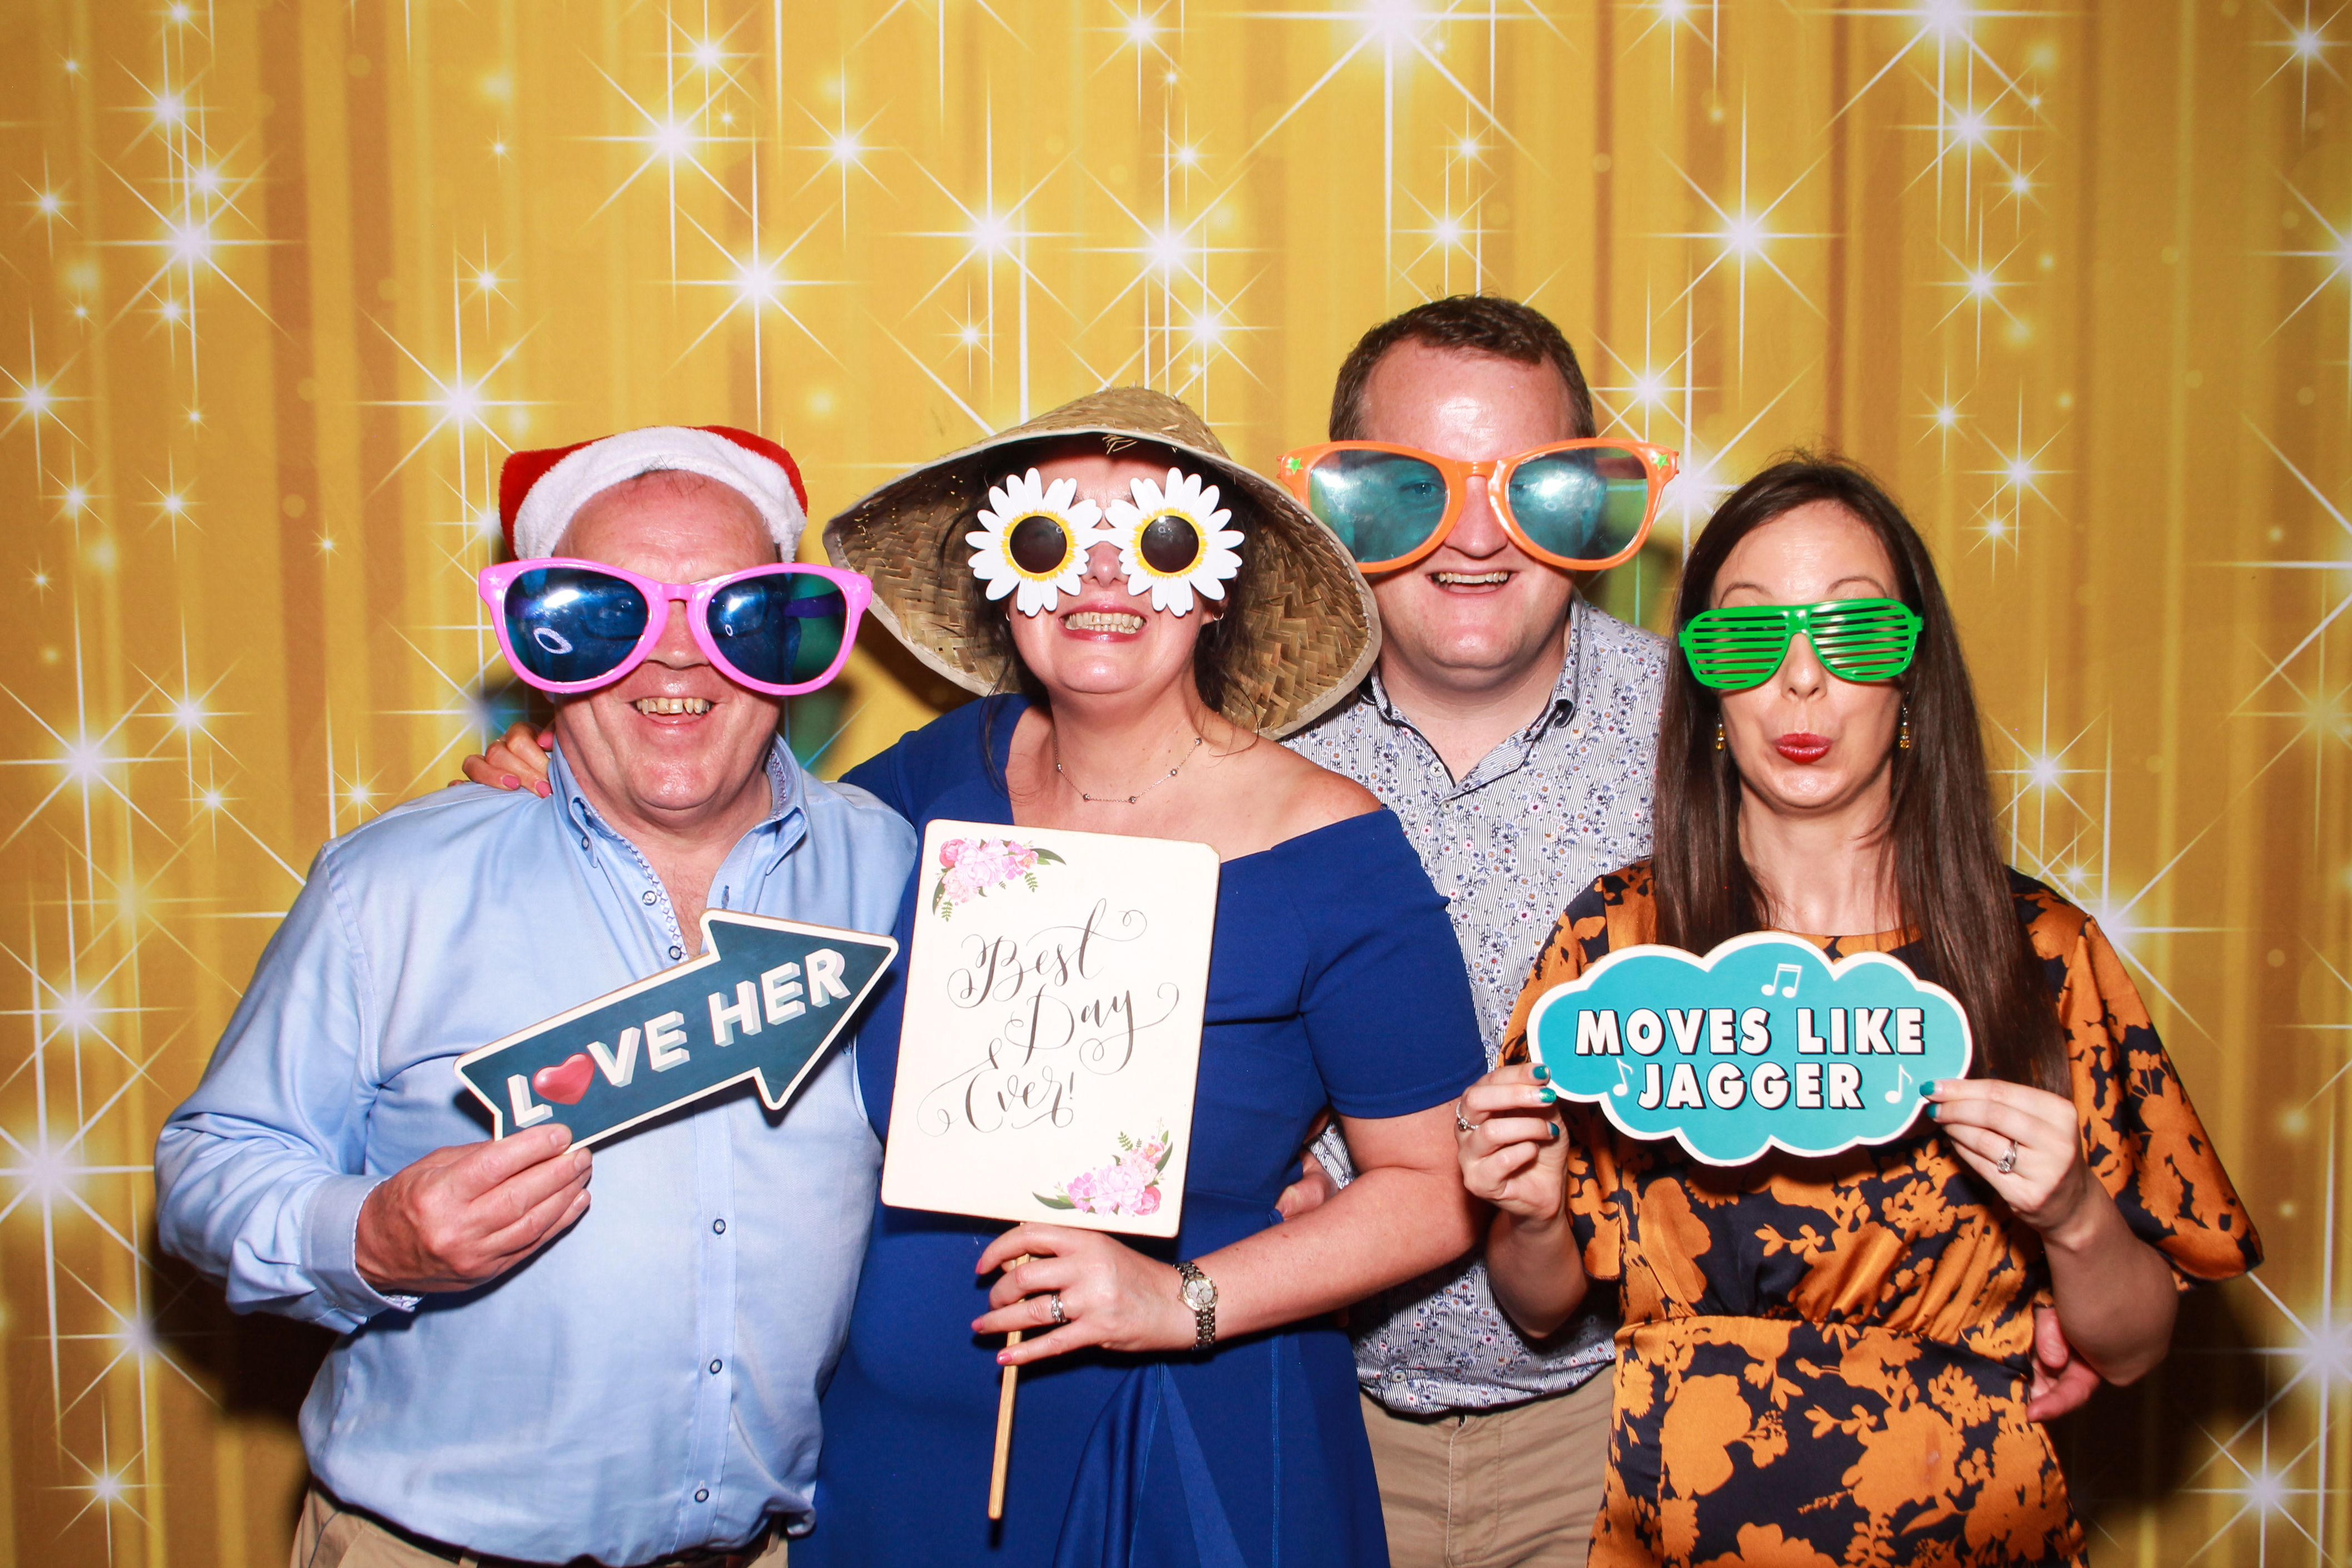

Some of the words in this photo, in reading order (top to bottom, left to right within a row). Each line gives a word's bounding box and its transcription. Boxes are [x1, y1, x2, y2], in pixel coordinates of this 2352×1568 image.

[708, 948, 851, 1047] HER
[947, 898, 1147, 1008] Best
[1004, 983, 1179, 1075] Day
[1574, 1006, 1771, 1055] MOVES
[1796, 1006, 1925, 1055] LIKE
[917, 1038, 1074, 1137] Ever!
[1638, 1061, 1865, 1110] JAGGER
